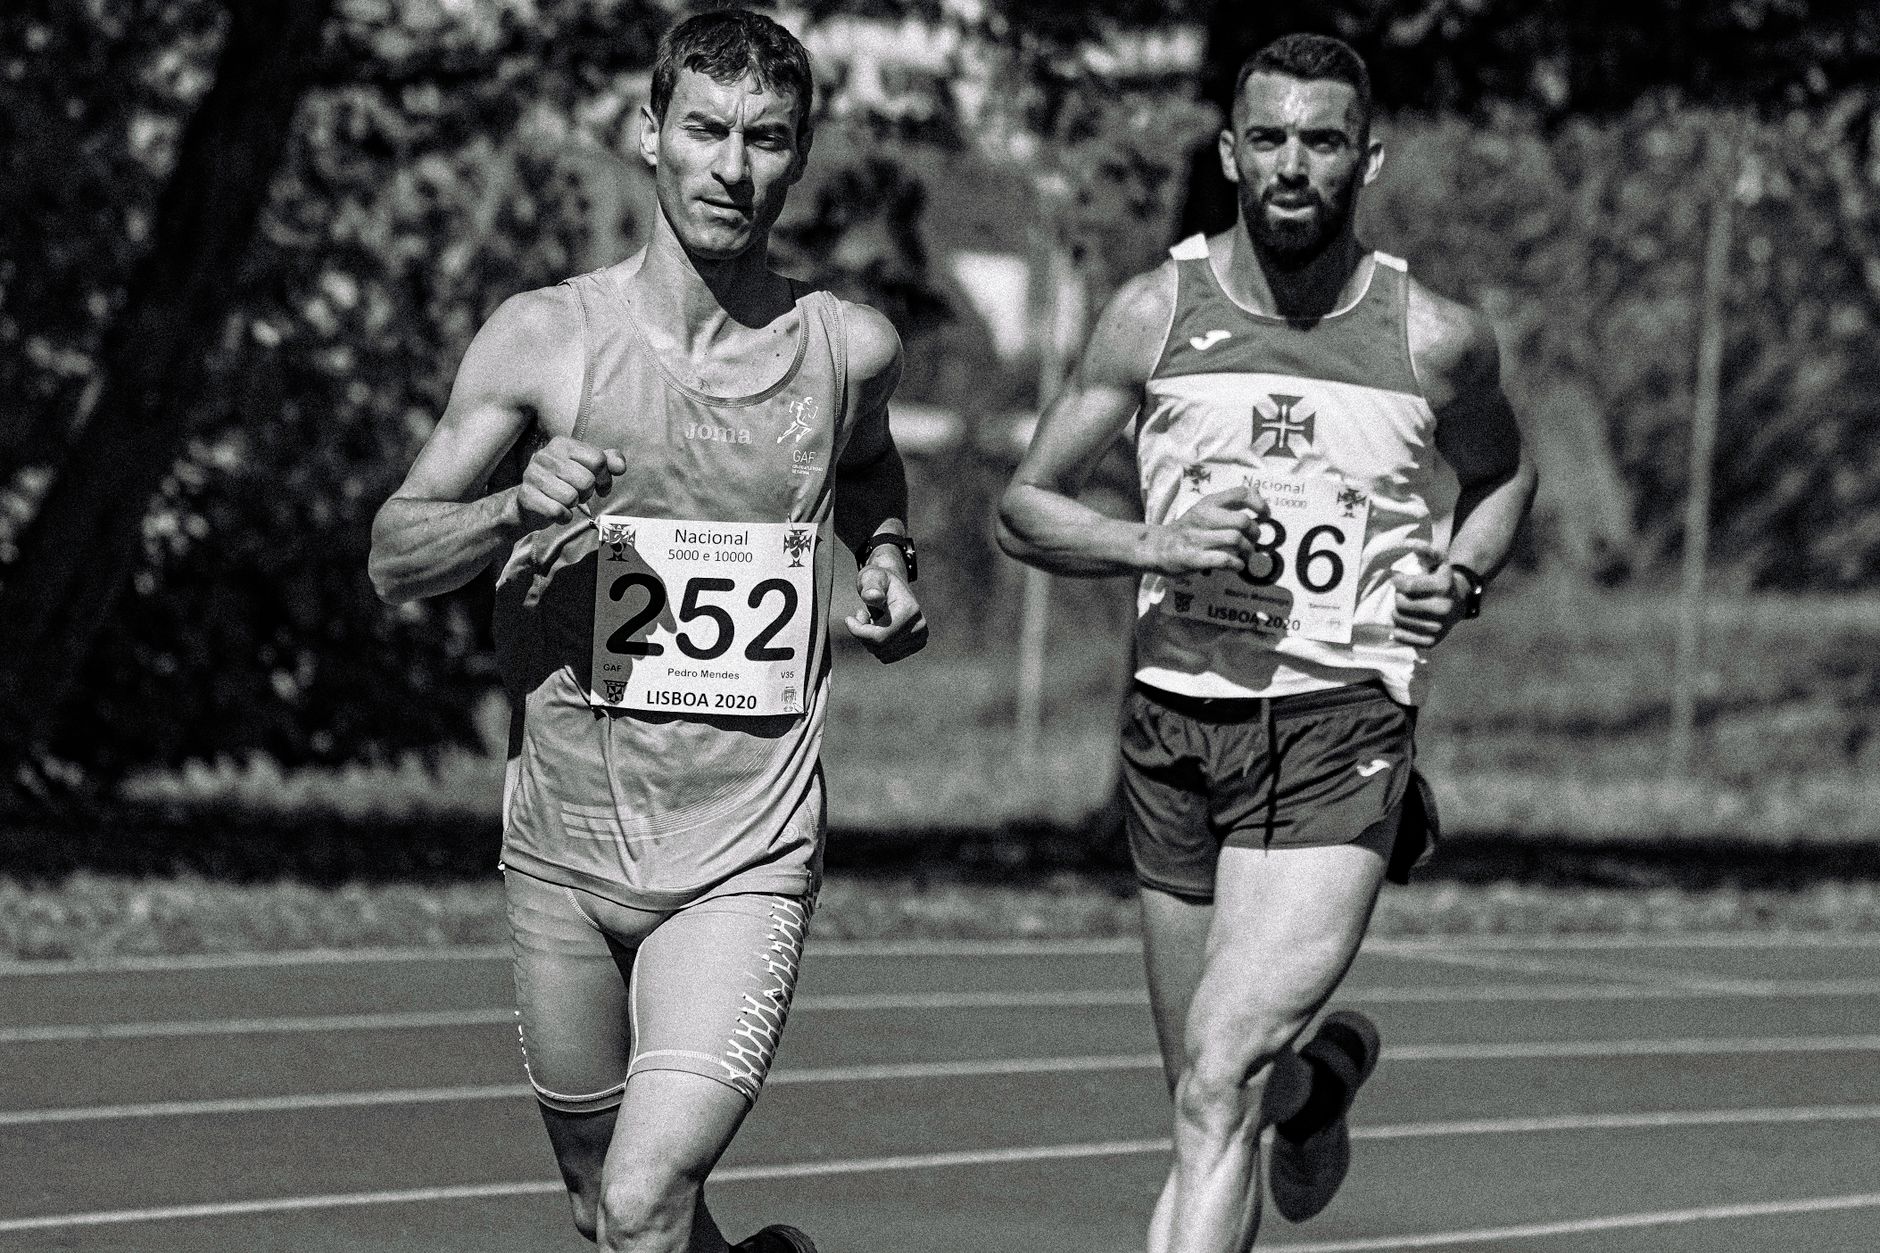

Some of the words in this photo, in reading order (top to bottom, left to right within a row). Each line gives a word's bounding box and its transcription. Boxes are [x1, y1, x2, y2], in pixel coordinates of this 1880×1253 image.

[793, 449, 816, 463] GAF
[675, 529, 748, 546] Nacional
[668, 549, 699, 561] 5000
[703, 552, 710, 562] e
[714, 551, 753, 563] 10000
[1202, 516, 1346, 594] 86
[606, 572, 798, 662] 252
[1208, 604, 1259, 624] LISBOA
[1264, 614, 1301, 631] 2020
[603, 664, 622, 672] GAF
[667, 668, 698, 678] Pedro
[701, 669, 740, 680] Mendes
[780, 671, 795, 679] V35
[646, 690, 709, 707] LISBOA
[714, 693, 757, 709] 2020
